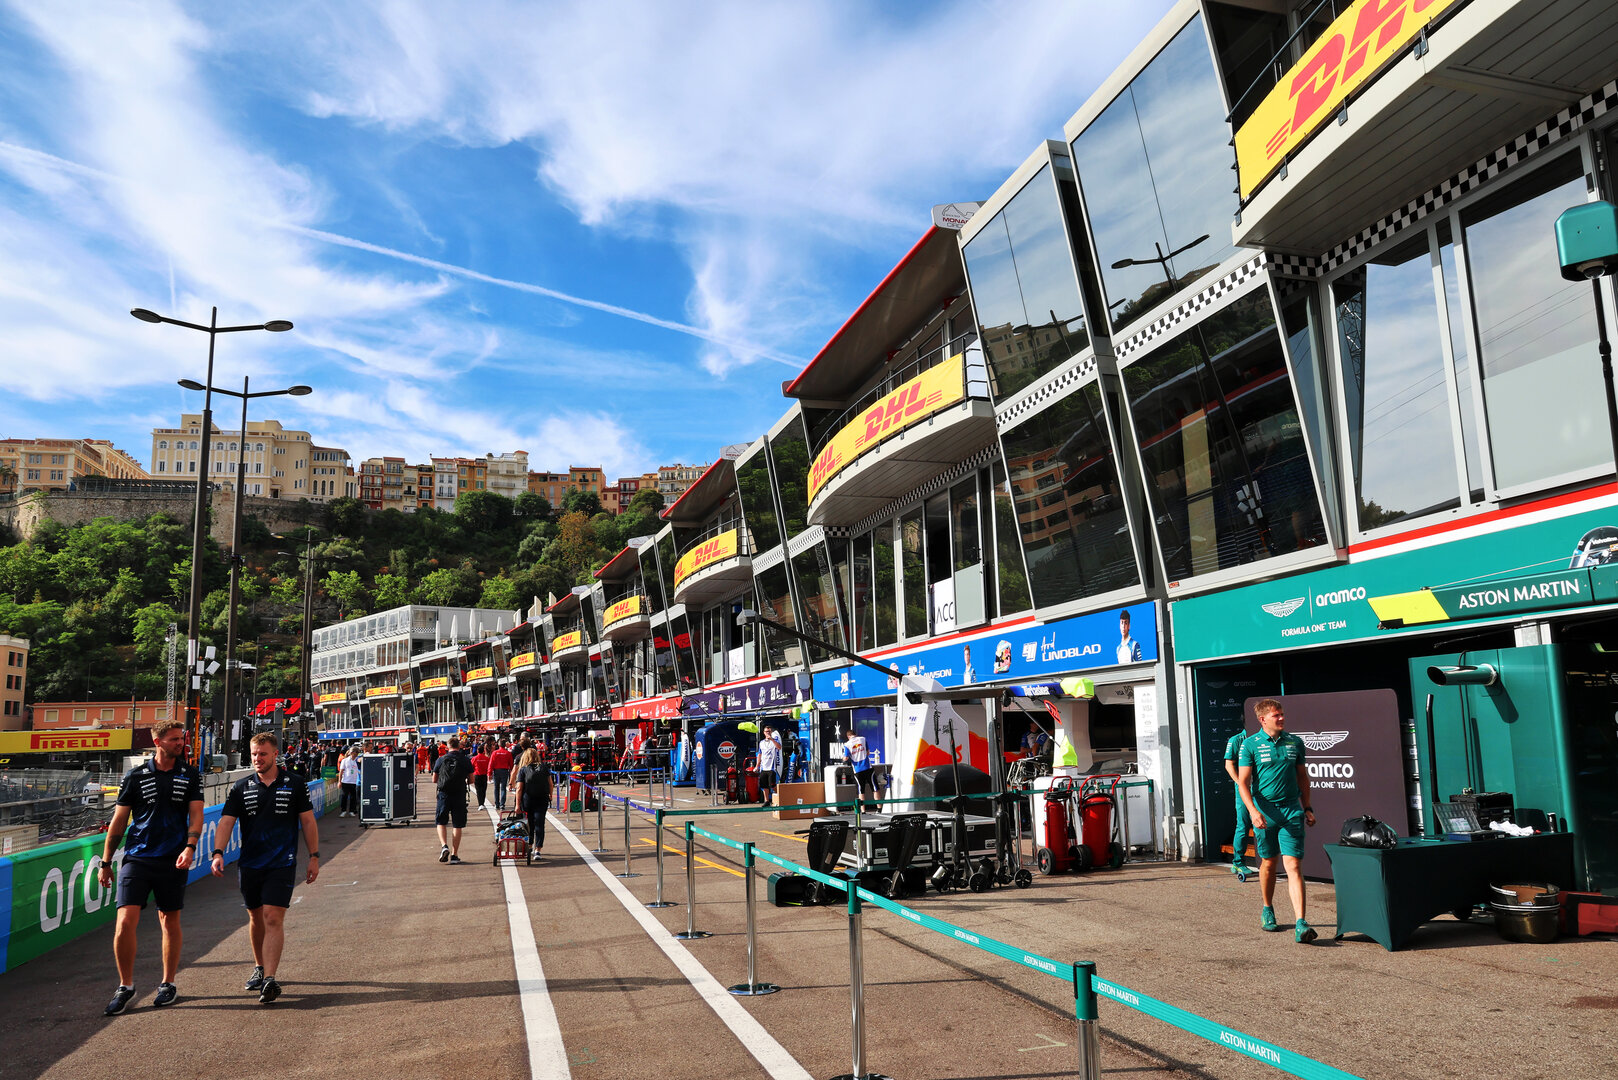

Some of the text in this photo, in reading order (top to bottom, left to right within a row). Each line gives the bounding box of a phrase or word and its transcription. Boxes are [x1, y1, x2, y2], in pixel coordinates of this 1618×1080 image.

[1289, 0, 1434, 135] DH
[864, 381, 927, 443] DHL
[812, 444, 837, 490] DHL
[694, 539, 721, 567] DHL
[1315, 587, 1366, 607] aramco
[1459, 578, 1580, 609] ASTON MARTIN
[613, 601, 630, 618] DHL
[1281, 620, 1347, 637] FORMULA ONE TEAM
[1042, 644, 1102, 662] LINDBLAD
[923, 668, 952, 680] AWSON
[30, 732, 111, 750] PIRELLI
[1304, 763, 1354, 778] amco
[966, 934, 980, 944] MARTIN
[1023, 955, 1056, 973] ASTON MARTIN
[1097, 981, 1139, 1006] ASTON MARTIN
[1219, 1031, 1281, 1064] ASTON MARTIN
